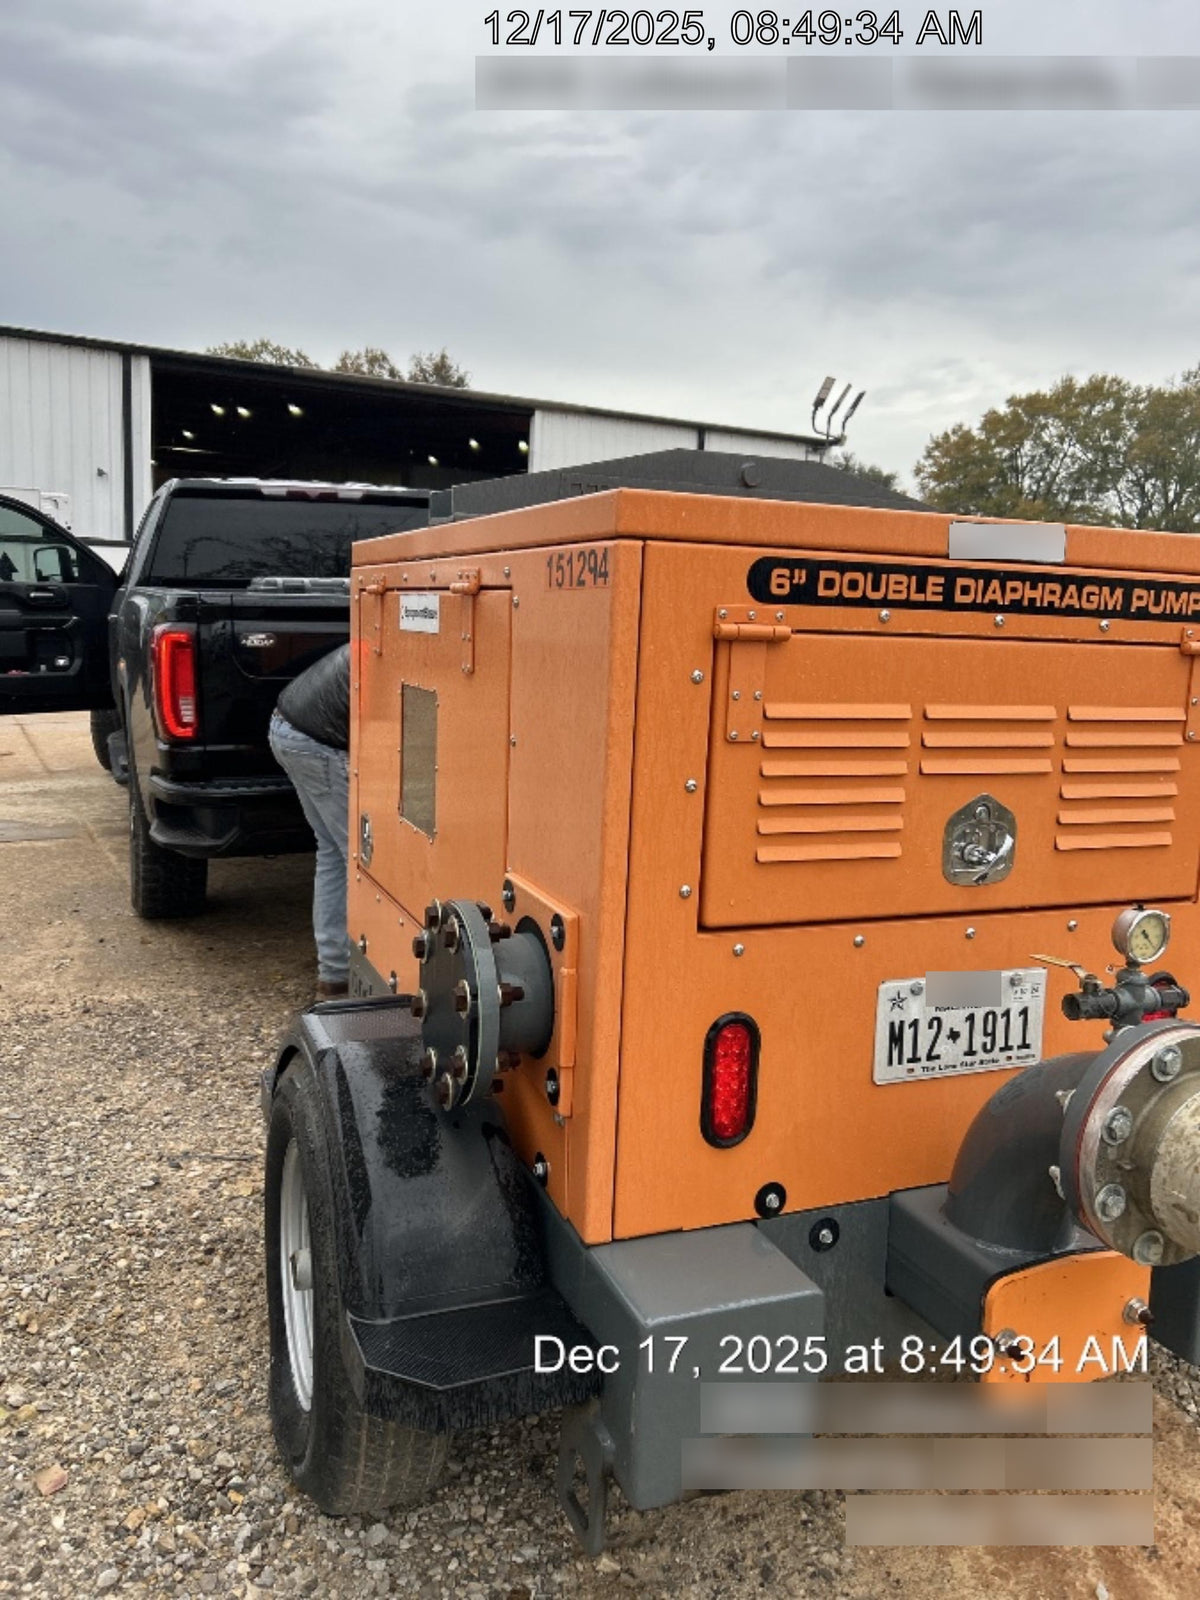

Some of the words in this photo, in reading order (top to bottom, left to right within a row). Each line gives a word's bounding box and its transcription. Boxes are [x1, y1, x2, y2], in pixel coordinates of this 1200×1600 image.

[547, 547, 609, 588] 151294
[817, 571, 945, 603] DOUBLE
[954, 577, 1123, 612] DIAPHRAGM
[1130, 588, 1200, 616] PUMP
